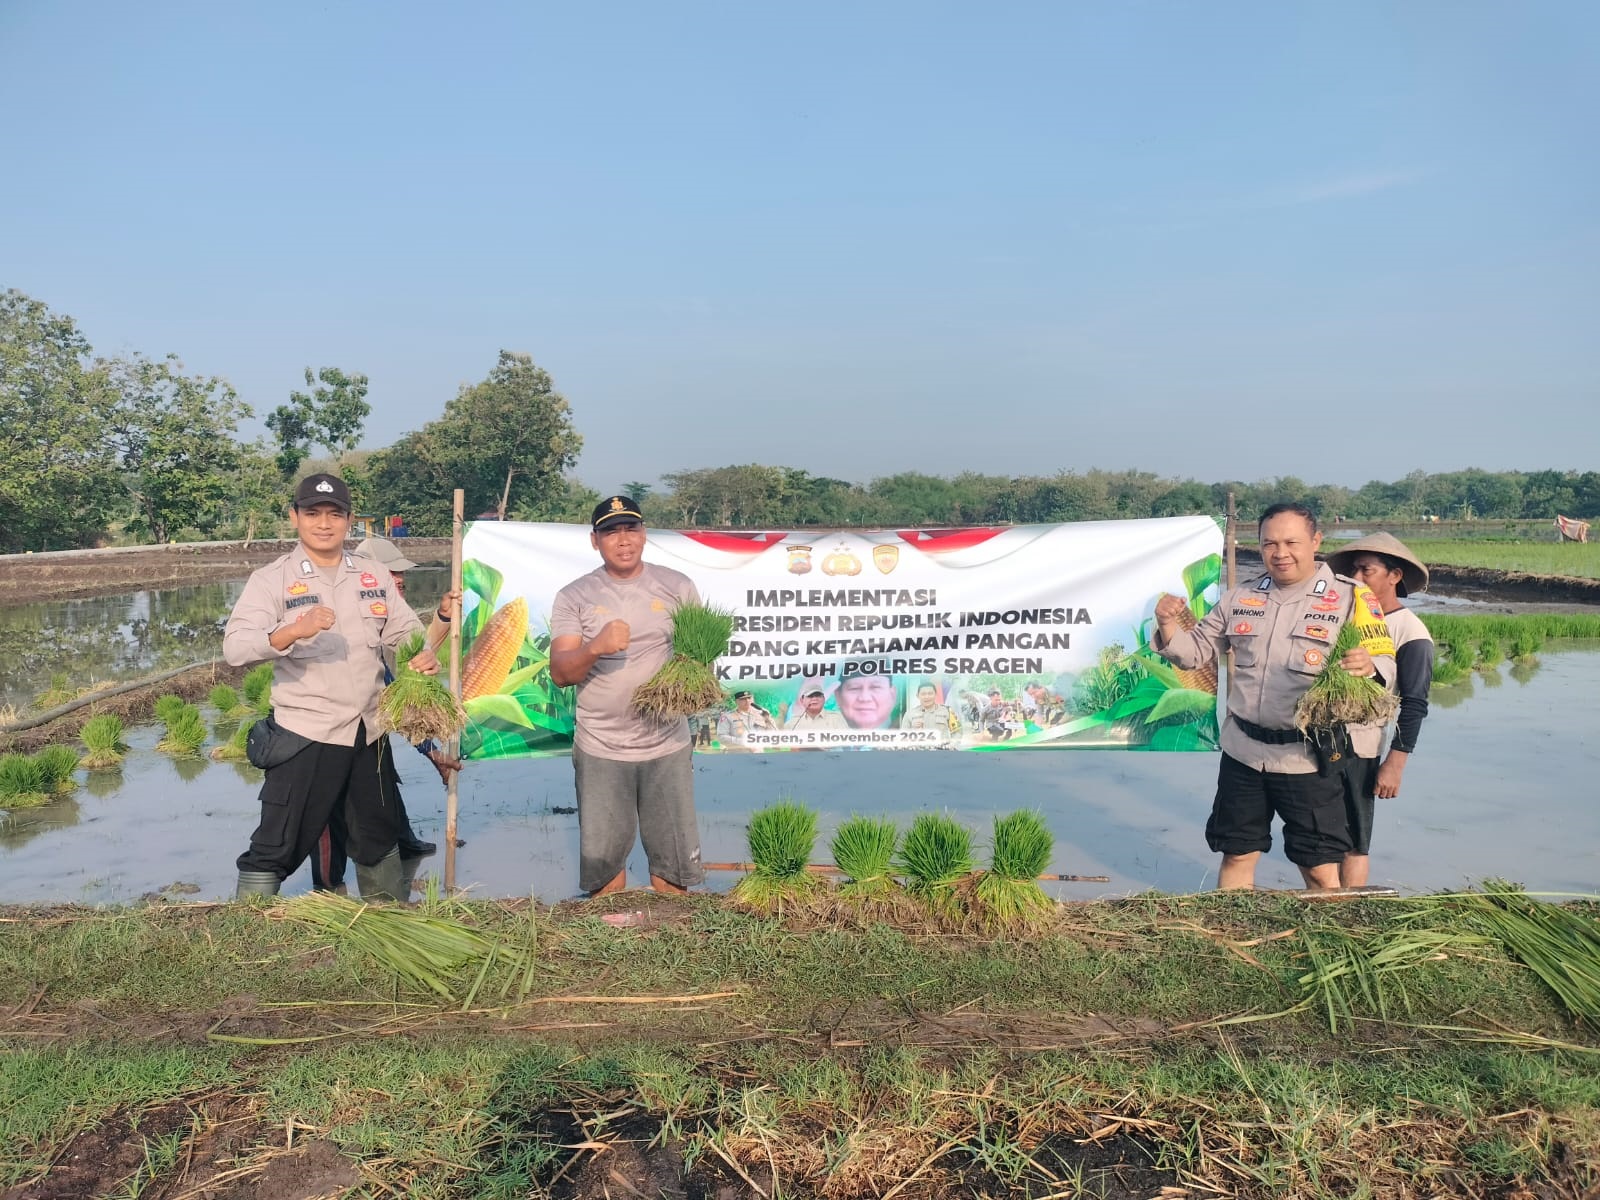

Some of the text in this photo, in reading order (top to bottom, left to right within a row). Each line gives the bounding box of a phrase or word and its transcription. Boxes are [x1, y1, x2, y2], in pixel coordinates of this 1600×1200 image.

[359, 589, 387, 600] POLR
[746, 589, 937, 608] IMPLEMENTASI
[733, 608, 1093, 632] RESIDEN REPUBLIK INDONESIA
[1232, 608, 1265, 618] WAHONO
[1303, 613, 1340, 624] POLRI
[806, 635, 959, 655] KETAHANAN
[965, 633, 1070, 650] PANGAN
[739, 663, 836, 680] PLUPUH
[843, 657, 937, 676] POLRES
[944, 657, 1043, 674] SRAGEN
[747, 731, 937, 745] Sragen, 5 November 2024
